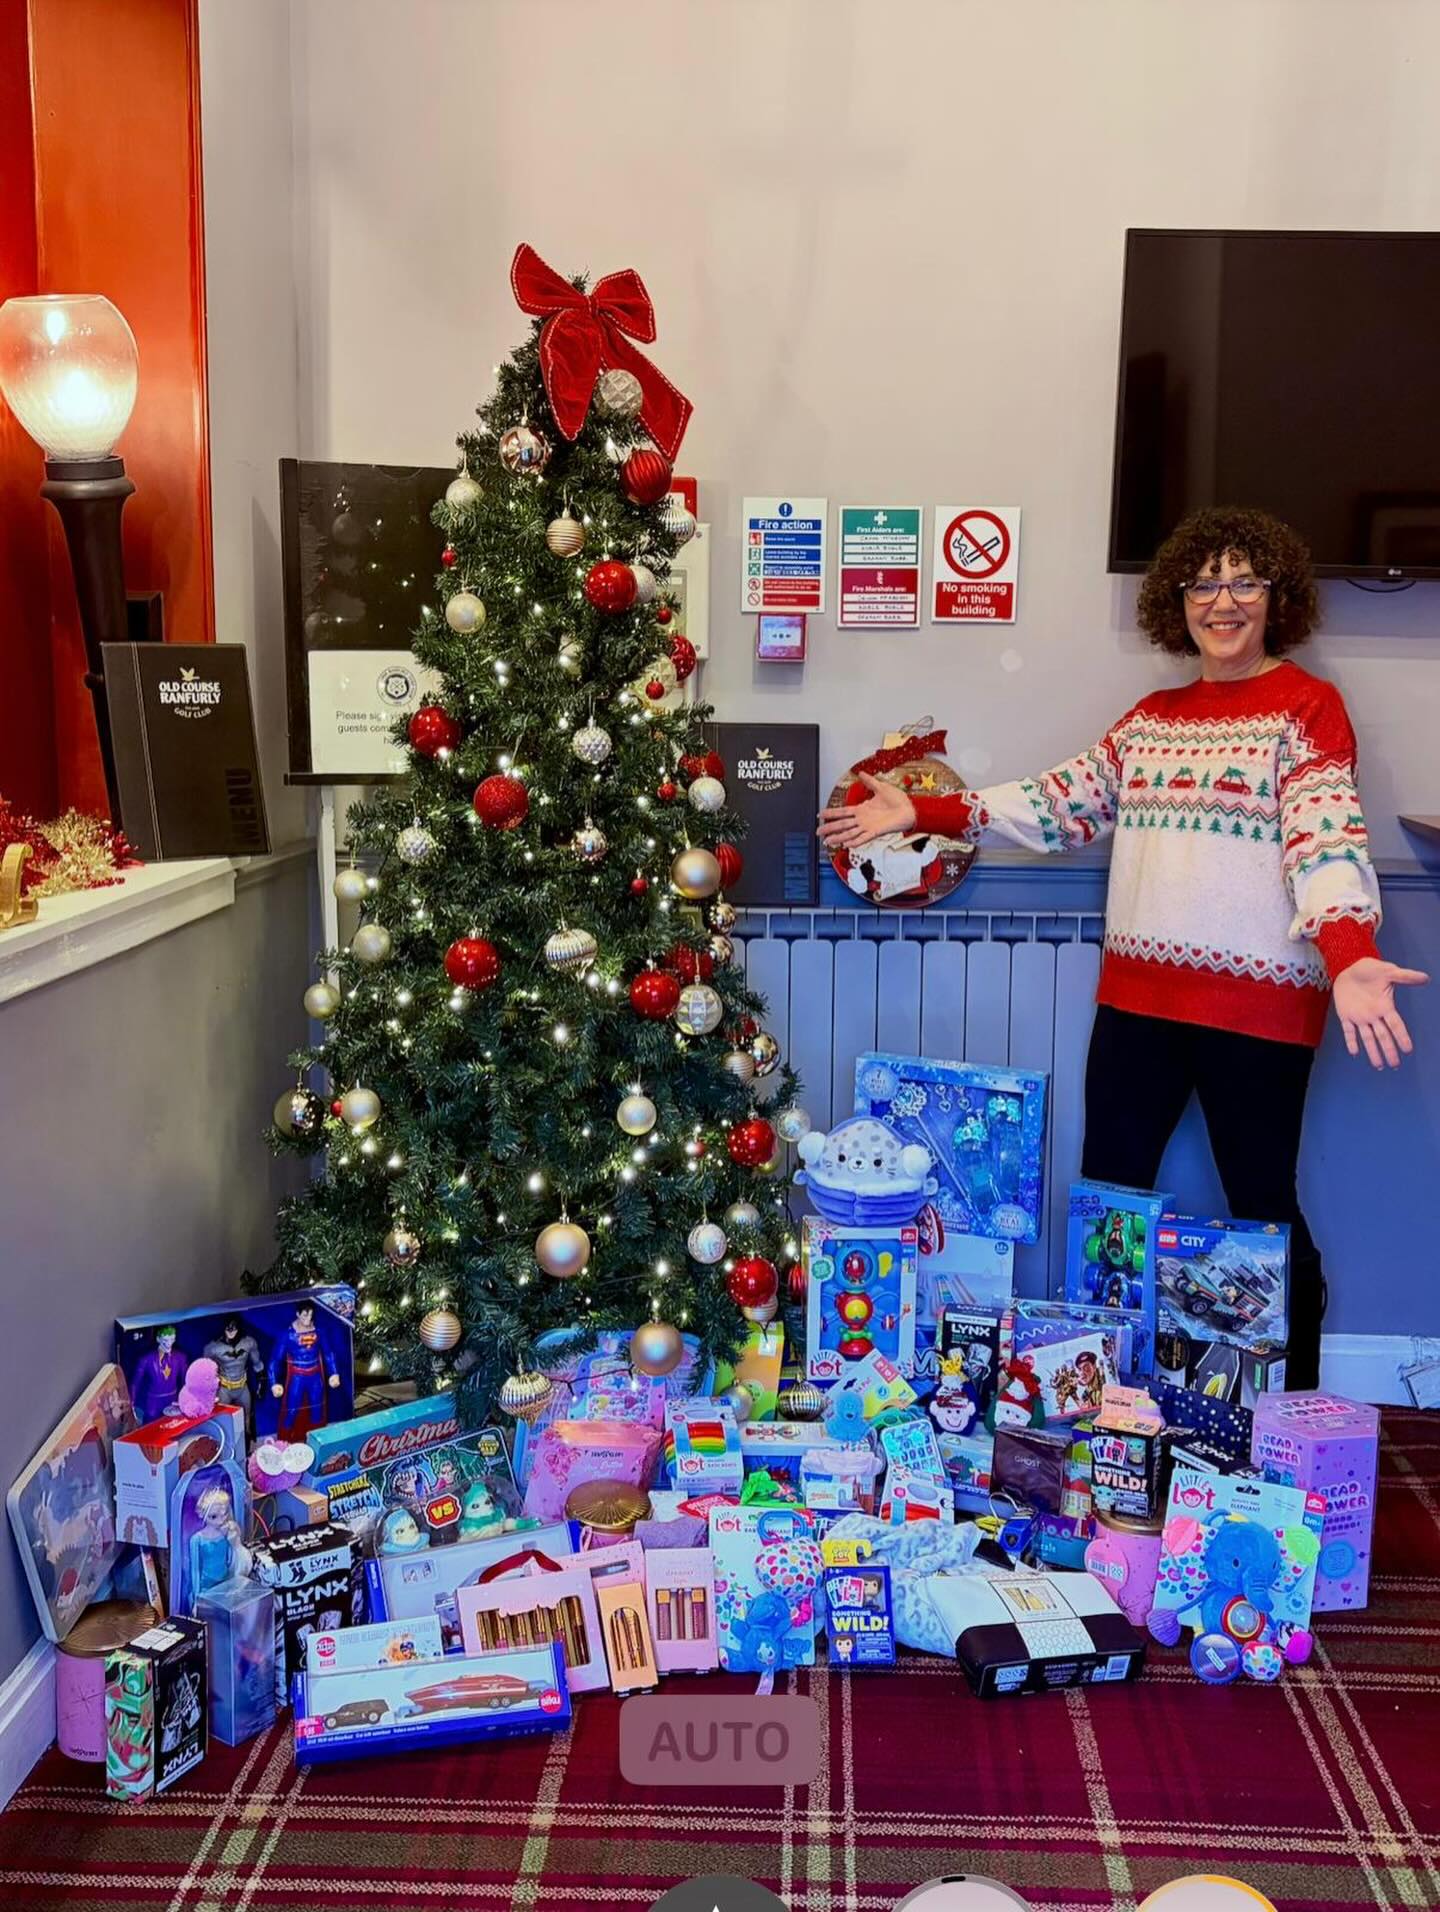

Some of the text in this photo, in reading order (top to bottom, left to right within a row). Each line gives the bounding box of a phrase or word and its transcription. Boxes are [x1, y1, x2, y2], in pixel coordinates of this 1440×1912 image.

[758, 520, 813, 529] Fire action
[942, 583, 1008, 596] No smoking
[957, 594, 991, 604] in this
[951, 605, 996, 617] building
[158, 682, 221, 692] OLD COURSE
[160, 692, 221, 704] RANFURLY
[174, 707, 212, 719] GOLF CLUB
[336, 711, 367, 720] Please
[337, 724, 368, 734] guests
[737, 760, 794, 769] OLD COURSE
[737, 769, 794, 779] RANFURLY
[747, 781, 782, 791] GOLF CLUB
[1181, 1235, 1206, 1247] CITY
[951, 1323, 990, 1337] LYNX
[359, 1418, 460, 1468] Christma
[1263, 1434, 1293, 1449] BEAD
[1258, 1445, 1299, 1464] TOWER
[1014, 1455, 1041, 1468] GHOST
[1094, 1471, 1147, 1491] WILD!
[330, 1487, 381, 1519] STRETCH
[1230, 1504, 1261, 1513] ELEPHANT
[1326, 1495, 1368, 1512] OWER
[432, 1502, 455, 1519] VS
[269, 1527, 334, 1550] LYNX
[310, 1554, 339, 1568] LYNX
[286, 1576, 349, 1607] LYNX
[832, 1616, 889, 1633] WILD!
